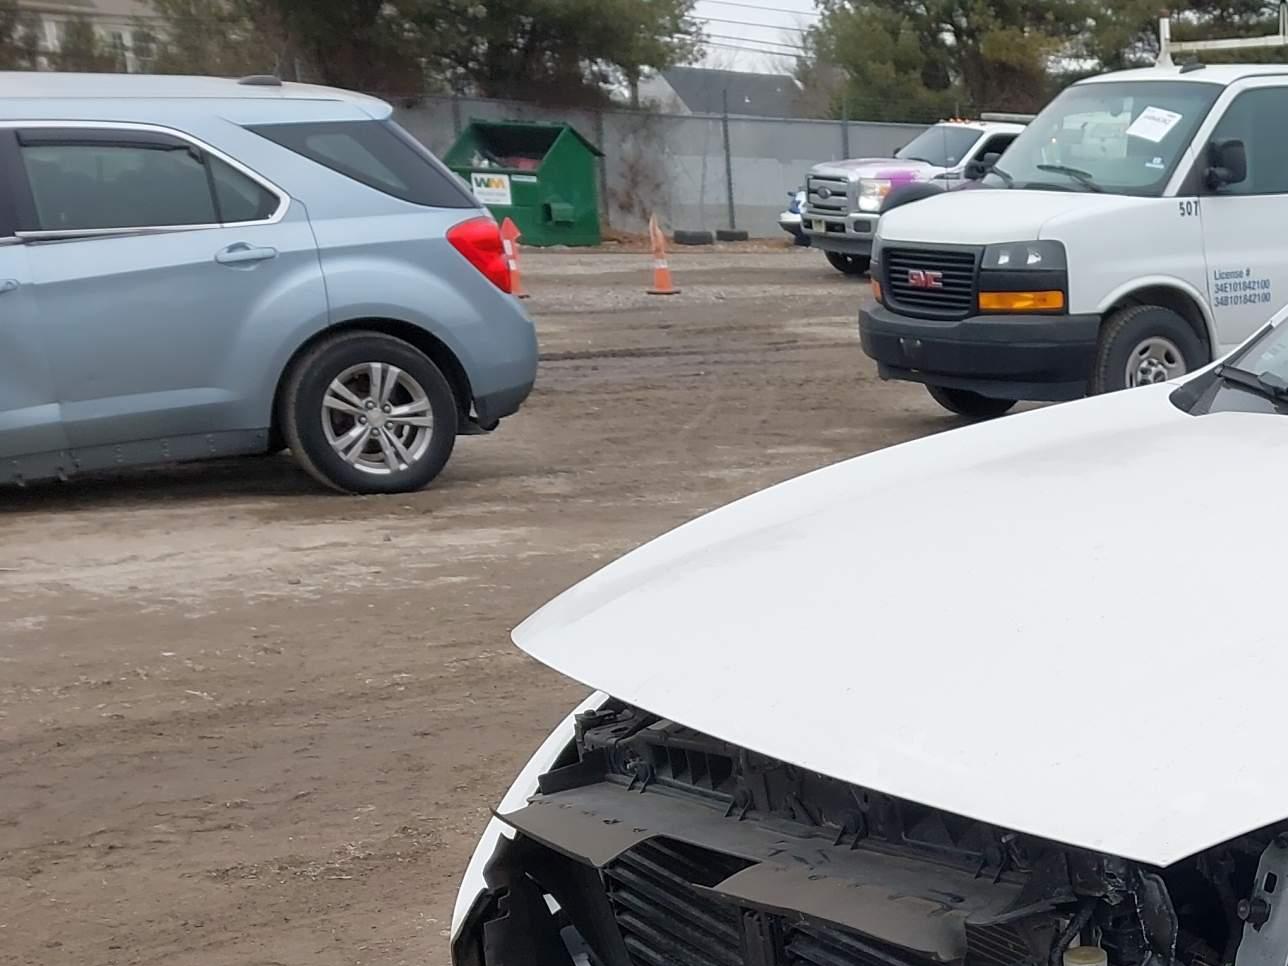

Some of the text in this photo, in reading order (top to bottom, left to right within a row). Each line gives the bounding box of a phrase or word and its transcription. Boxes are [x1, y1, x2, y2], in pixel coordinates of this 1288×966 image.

[1179, 200, 1199, 217] 507
[908, 269, 943, 288] GMC
[1214, 269, 1244, 281] License
